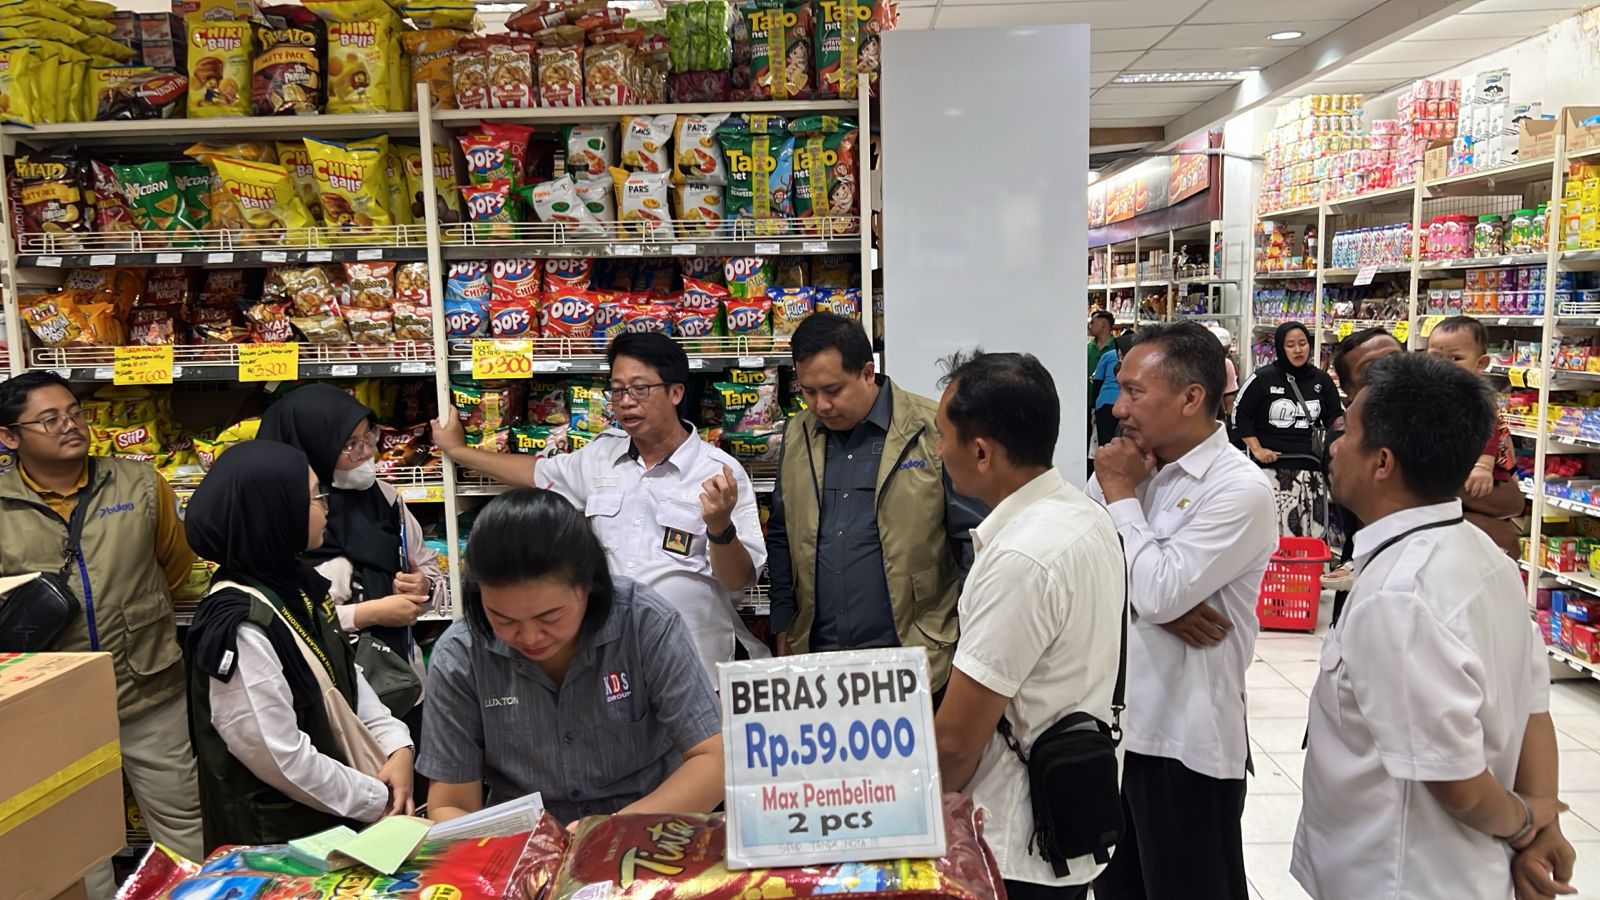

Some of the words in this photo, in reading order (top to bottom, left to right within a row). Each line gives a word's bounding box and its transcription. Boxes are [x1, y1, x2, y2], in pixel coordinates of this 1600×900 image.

[747, 11, 798, 32] Tao
[821, 1, 871, 23] Tao
[191, 26, 242, 48] CHIKI
[328, 21, 376, 43] CHIKI
[340, 34, 375, 48] Balls
[207, 37, 242, 51] Balls
[725, 149, 777, 172] Tao
[794, 147, 838, 171] Tao
[313, 158, 366, 182] CHIKI
[223, 179, 277, 203] CHIKI
[329, 173, 364, 193] Balls
[628, 185, 649, 193] PARS
[240, 195, 276, 210] Balls
[494, 258, 537, 279] OOPS
[545, 258, 589, 273] OOPS
[550, 301, 595, 319] OOPS
[683, 293, 720, 310] OOPS
[491, 310, 531, 335] OOPS
[727, 310, 766, 331] OOPS
[731, 369, 767, 383] Taro
[453, 391, 481, 405] Taro
[722, 389, 760, 406] Taro
[516, 434, 547, 449] Taro
[731, 440, 769, 455] Taro
[107, 501, 135, 515] bulog
[281, 606, 308, 639] NASIONAL
[603, 672, 629, 696] KDS
[731, 674, 828, 715] BERAS
[837, 668, 917, 708] SPHP
[485, 696, 519, 708] LUXTON
[607, 690, 632, 703] GROUP
[745, 716, 915, 777] Rp.59.000
[762, 785, 799, 811] Max
[803, 779, 897, 808] Pembelian
[788, 813, 809, 834] 2
[821, 811, 873, 837] pcs
